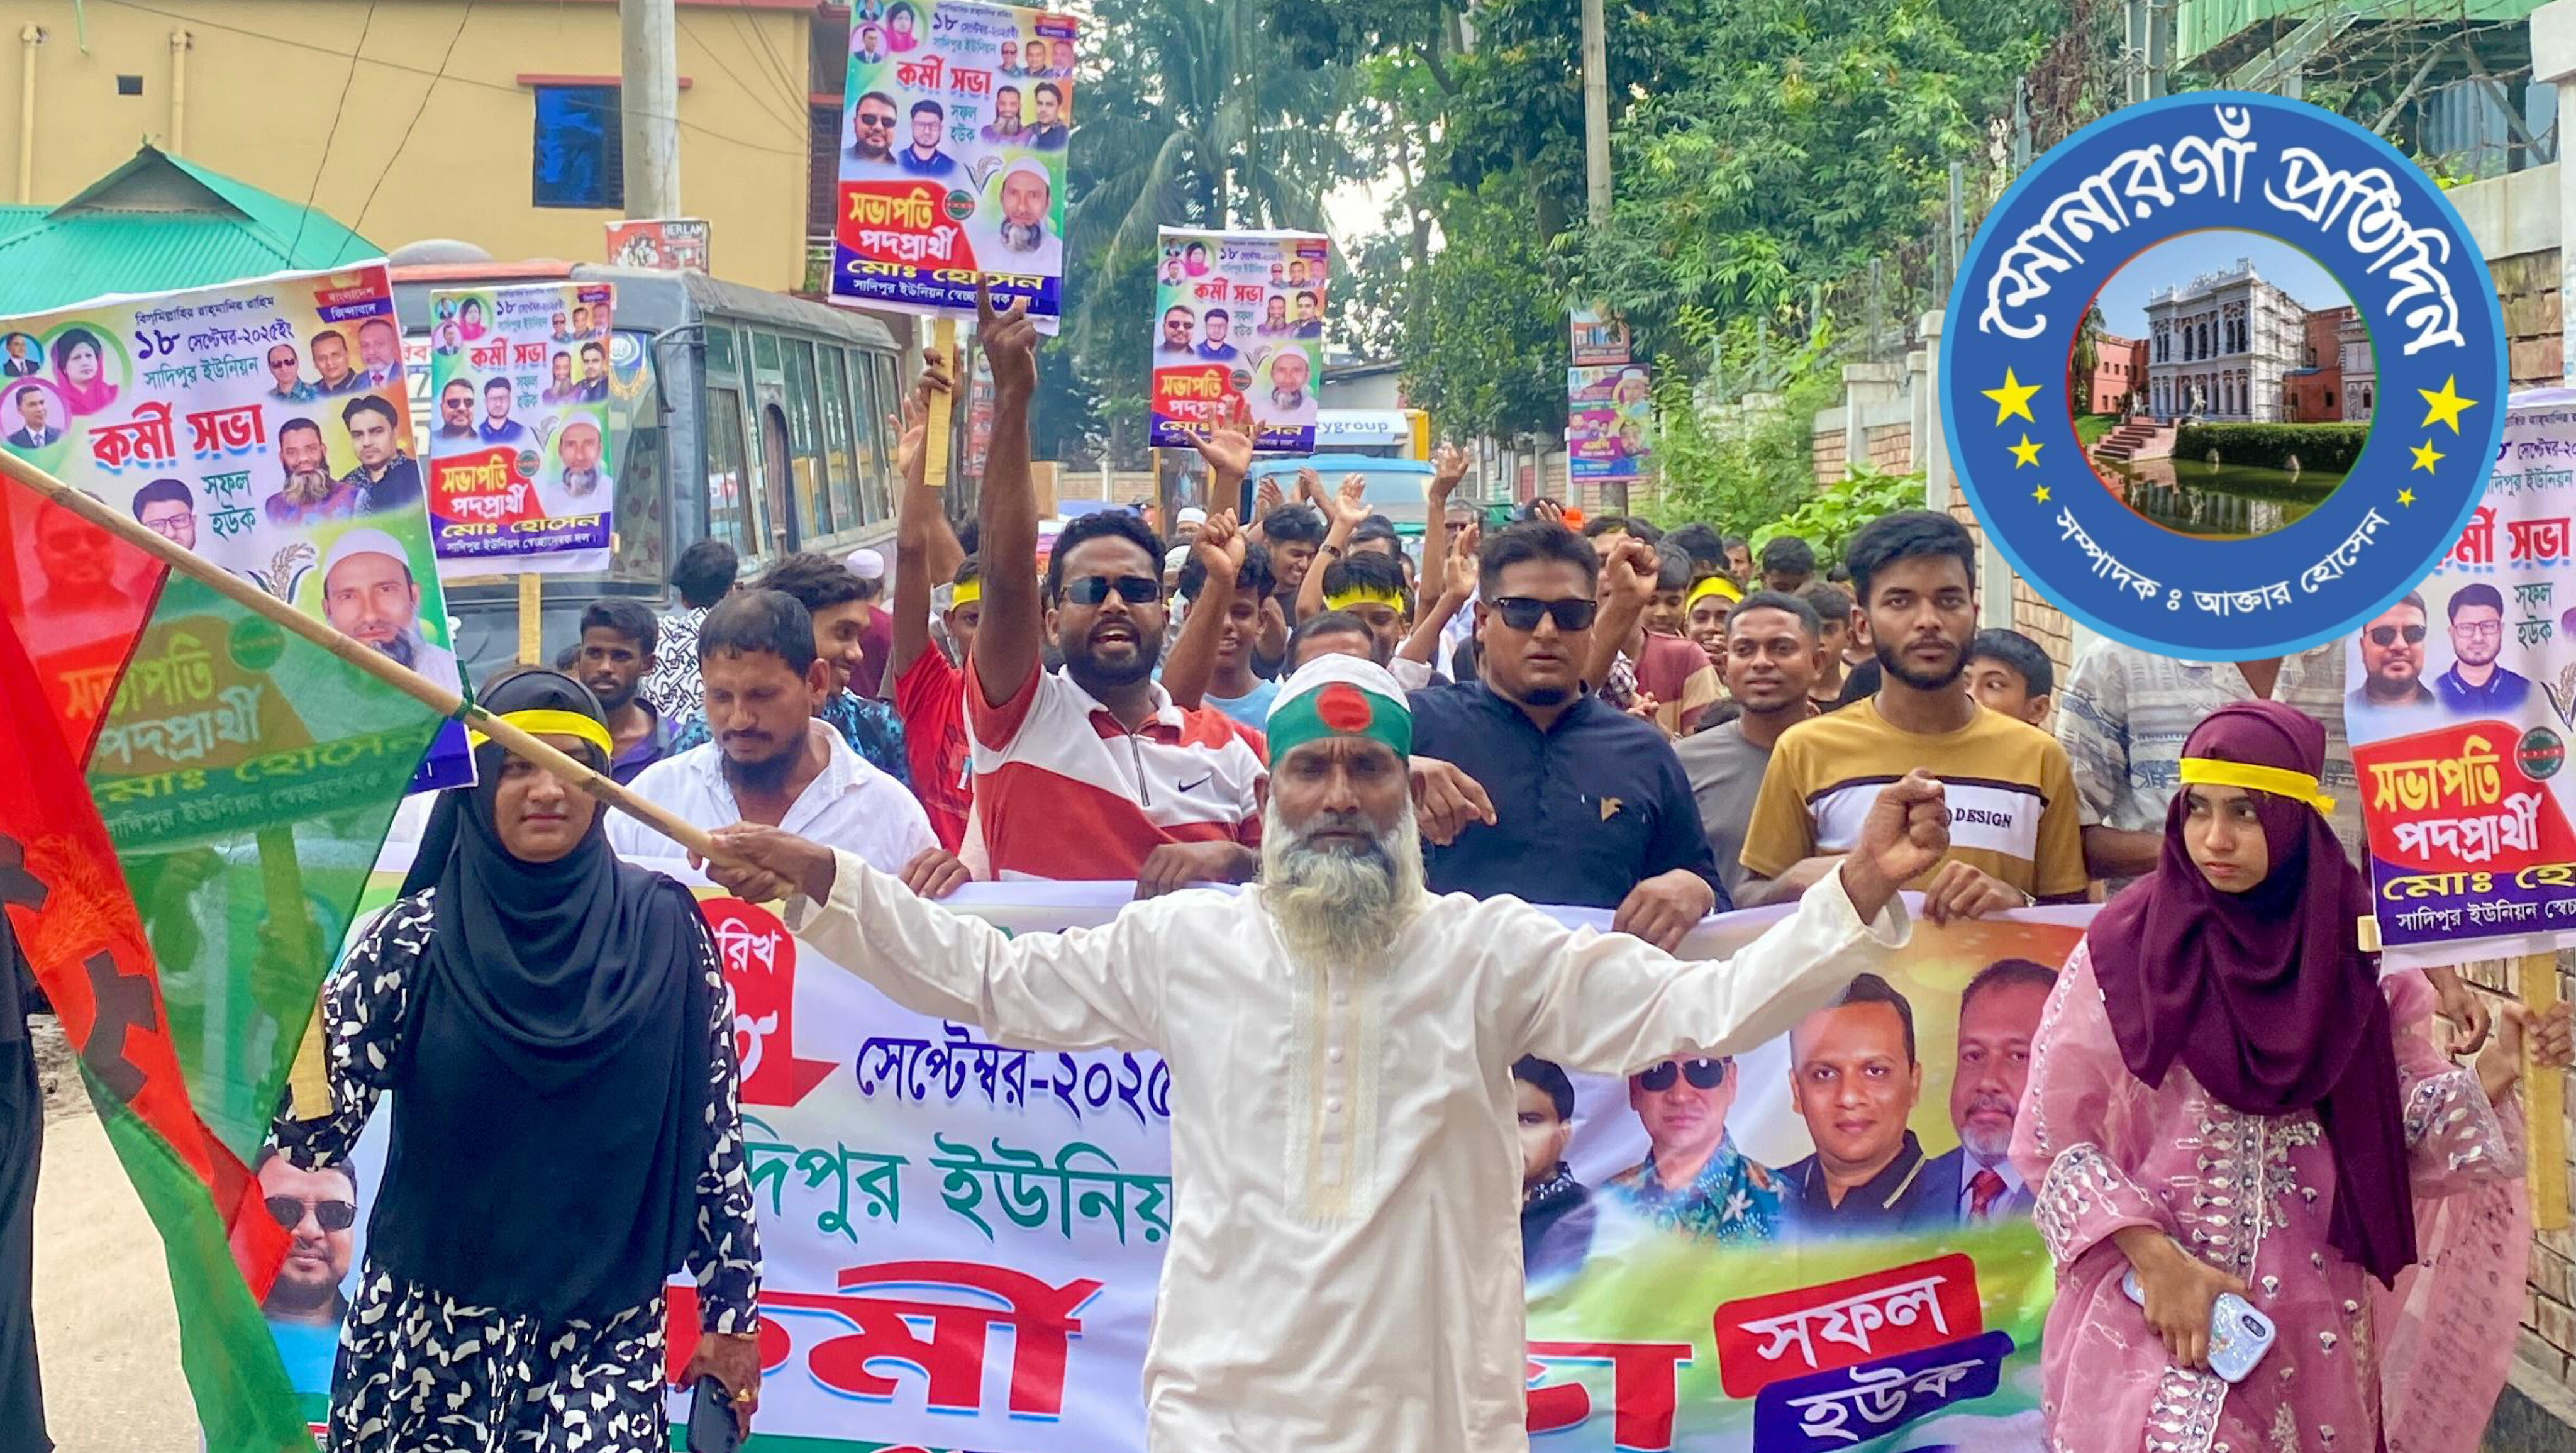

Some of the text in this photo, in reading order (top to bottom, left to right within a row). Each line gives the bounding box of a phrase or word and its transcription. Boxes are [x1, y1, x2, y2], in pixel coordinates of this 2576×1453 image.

[933, 13, 958, 30] ১৮
[897, 54, 992, 94] কর্মী সভা
[950, 123, 976, 144] হউক
[849, 187, 934, 229] সভাপতি
[859, 225, 958, 261] পদপ্রার্থী
[1220, 247, 1237, 260] ১৮
[847, 260, 917, 278] মোঃ
[853, 278, 896, 296] সাদিপুর
[1194, 277, 1264, 302] কর্মী সভা
[497, 301, 515, 315] ১৮
[135, 330, 180, 359] ১৮
[470, 337, 547, 368] কর্মী সভা
[143, 354, 258, 390] সাদিপুর ইউনিয়ন
[1161, 370, 1222, 398] সভাপতি
[89, 401, 266, 467] কর্মী সভা
[1316, 420, 1389, 433] tygroup
[201, 470, 252, 501] সফল
[441, 454, 507, 493] সভাপতি
[2487, 465, 2573, 496] াদিপুর ইউনিয়ন
[450, 484, 528, 519] পদপ্রার্থী
[208, 505, 256, 542] হউক
[441, 514, 601, 538] মোঃ হোসেন
[2438, 506, 2571, 565] র্মী সভা
[2514, 582, 2553, 611] সফল
[2515, 613, 2553, 650] হউক
[60, 633, 212, 719] সভাপতি
[2368, 735, 2501, 813] সভাপতি
[1955, 808, 2013, 829] DESIGN
[2394, 793, 2542, 863] পদপ্রার্থী
[2383, 871, 2492, 901] মোঃ
[2396, 906, 2462, 931] সাদিপুর
[2467, 899, 2538, 926] ইউনিয়ন
[711, 917, 782, 974] রিখ
[856, 1020, 1171, 1125] সেপ্টেম্বর-২০২৫
[742, 1114, 1172, 1245] দিপুর ইউনিয়
[1738, 1274, 1948, 1368] সফল
[1787, 1359, 1984, 1442] হউক
